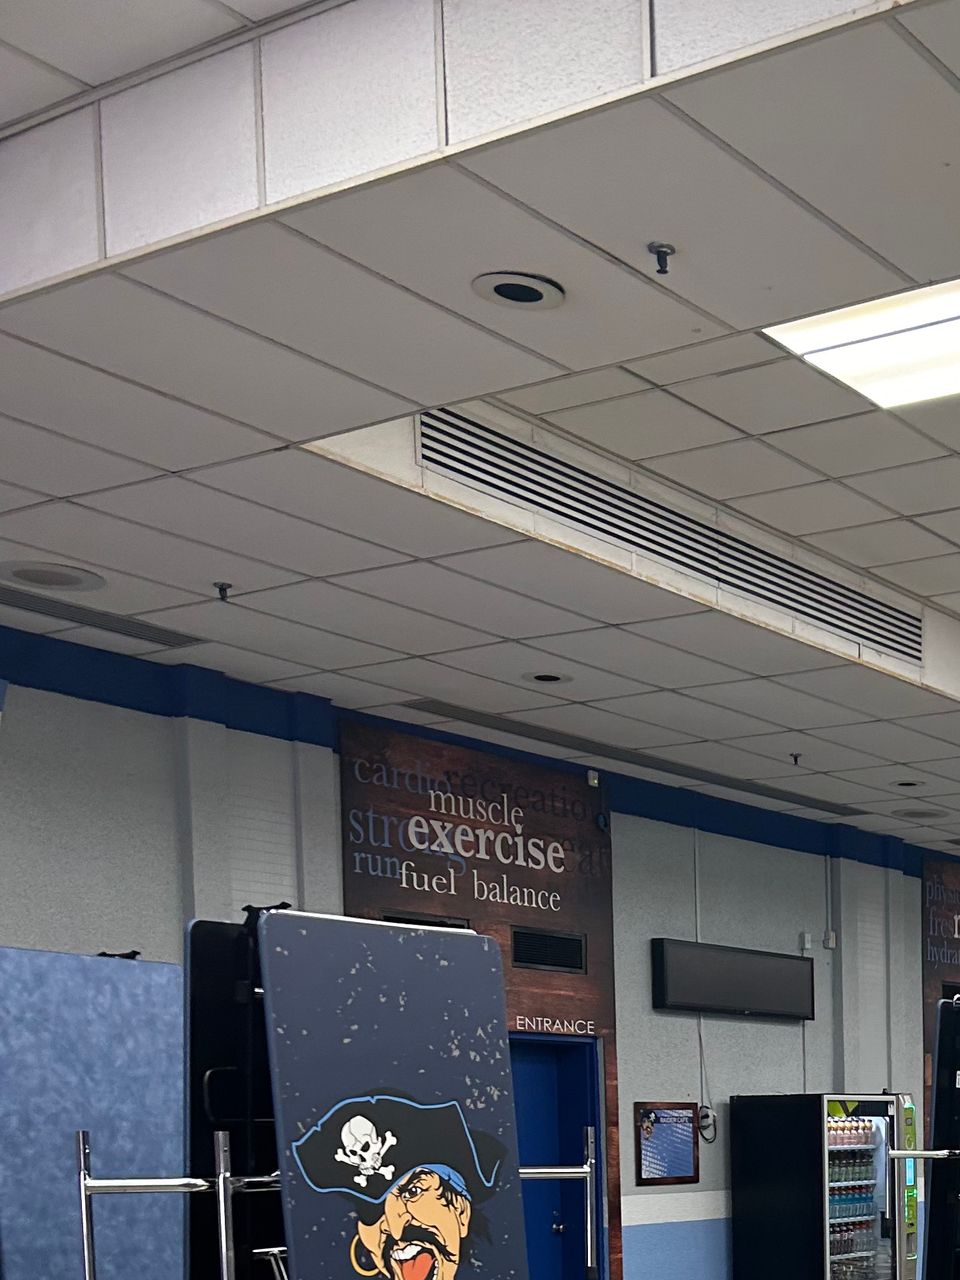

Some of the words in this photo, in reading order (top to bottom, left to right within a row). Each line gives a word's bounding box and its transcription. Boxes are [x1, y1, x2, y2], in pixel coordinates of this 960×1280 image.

[354, 759, 451, 795] cardio
[428, 789, 524, 827] muscle
[408, 815, 565, 873] exercise
[353, 852, 400, 879] run
[400, 861, 457, 895] fuel
[472, 870, 561, 911] balance
[516, 1016, 595, 1034] ENTRANCE
